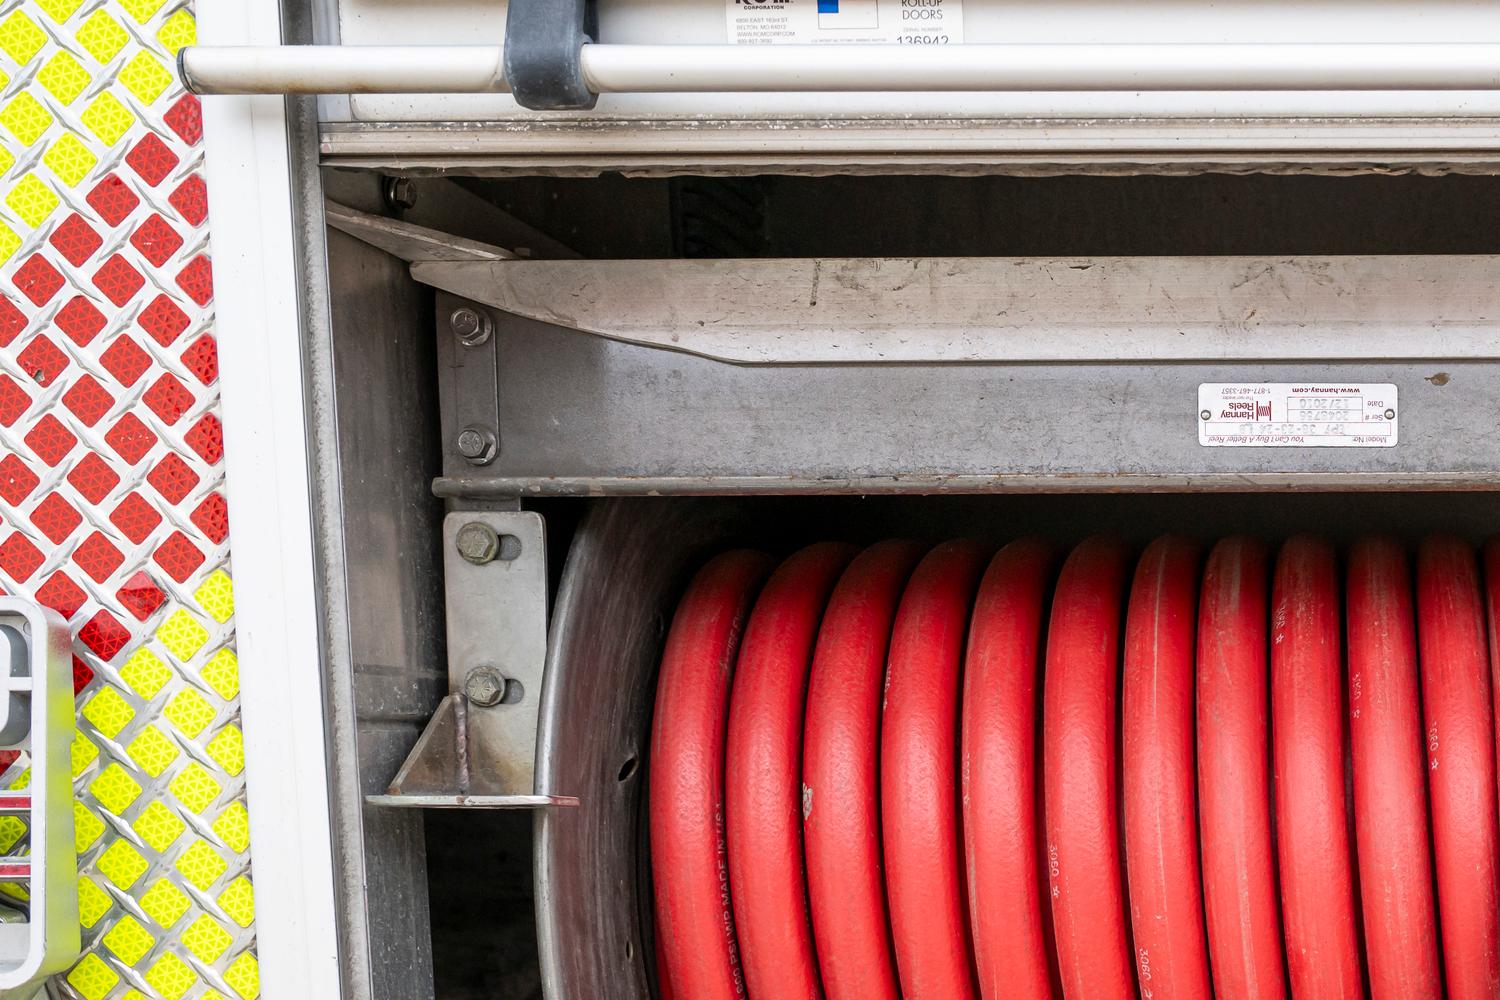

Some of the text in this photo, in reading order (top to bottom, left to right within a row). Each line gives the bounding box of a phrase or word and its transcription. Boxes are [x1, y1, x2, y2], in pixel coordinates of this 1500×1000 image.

[902, 9, 943, 20] DOORS
[897, 35, 950, 45] 136942
[1229, 402, 1255, 410] Reels
[1221, 410, 1255, 420] Hannay
[717, 859, 732, 906] MADE
